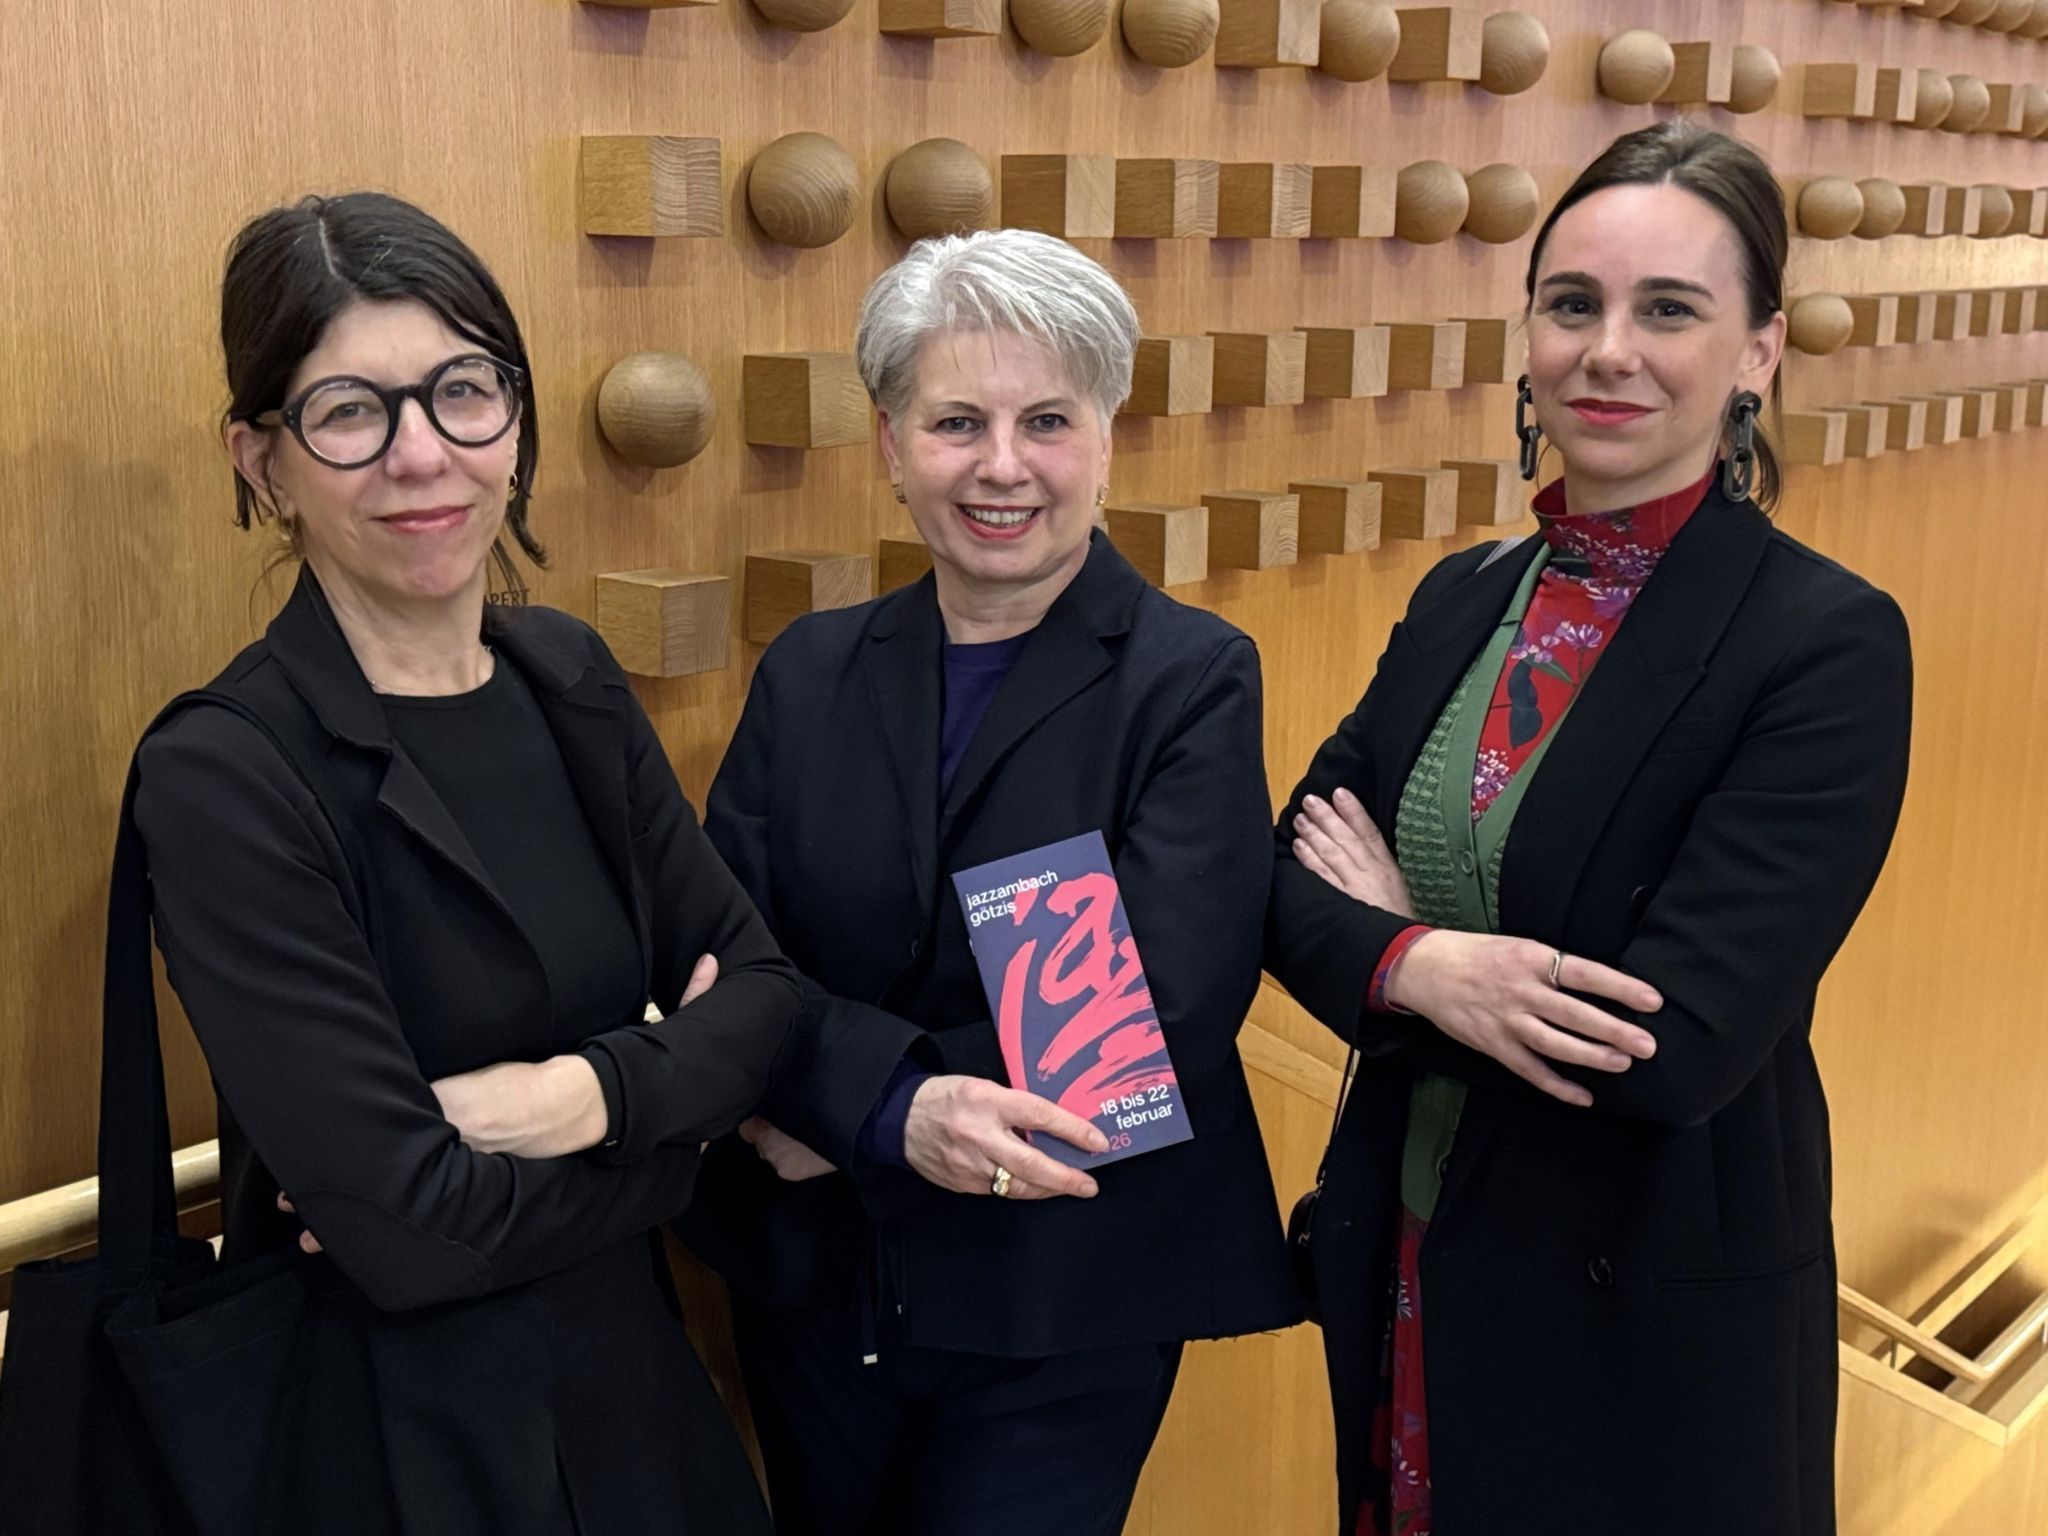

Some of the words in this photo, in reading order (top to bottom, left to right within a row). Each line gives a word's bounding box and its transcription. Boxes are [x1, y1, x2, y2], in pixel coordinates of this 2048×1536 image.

[965, 869, 1059, 911] jazzambach
[970, 900, 1017, 927] götzis
[1099, 1098, 1118, 1116] 18
[1119, 1092, 1145, 1111] bis
[1147, 1083, 1170, 1103] 22
[1115, 1102, 1173, 1131] februar
